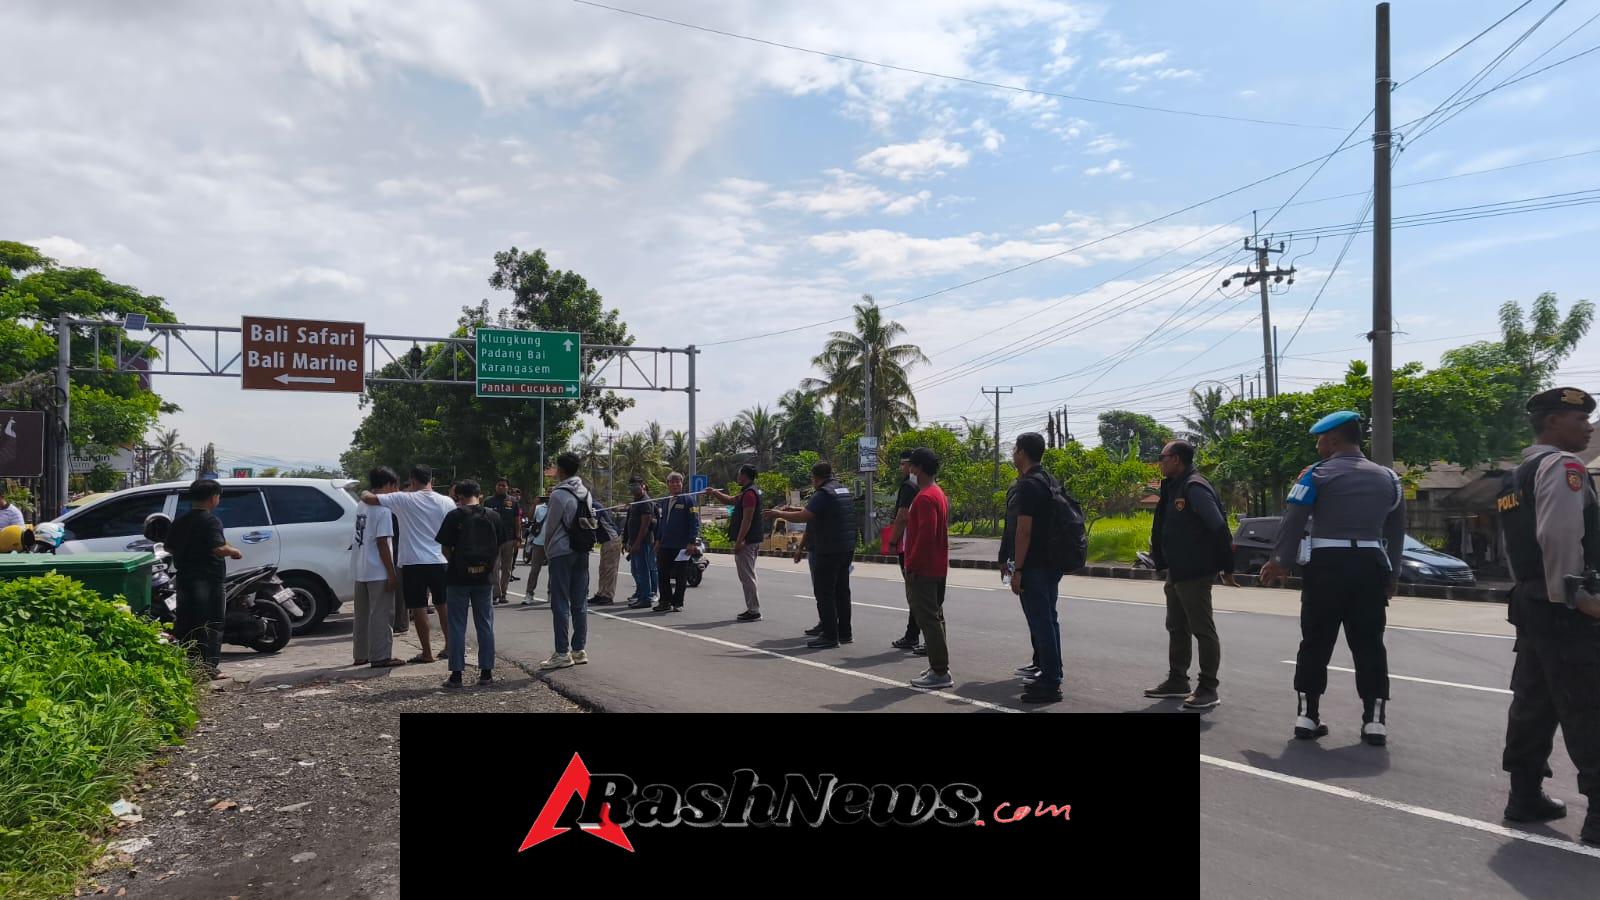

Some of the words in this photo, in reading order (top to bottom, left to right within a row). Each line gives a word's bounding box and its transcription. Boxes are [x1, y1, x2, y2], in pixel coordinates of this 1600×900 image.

[250, 324, 289, 342] Bali
[296, 327, 355, 346] Safari
[481, 333, 541, 347] Klungkung
[481, 348, 522, 360] Padang
[527, 350, 546, 359] Bai
[248, 350, 285, 368] Bali
[292, 352, 358, 372] Marine
[481, 363, 551, 374] Karangasem
[481, 383, 515, 392] Pantai
[520, 384, 564, 393] Cucukan
